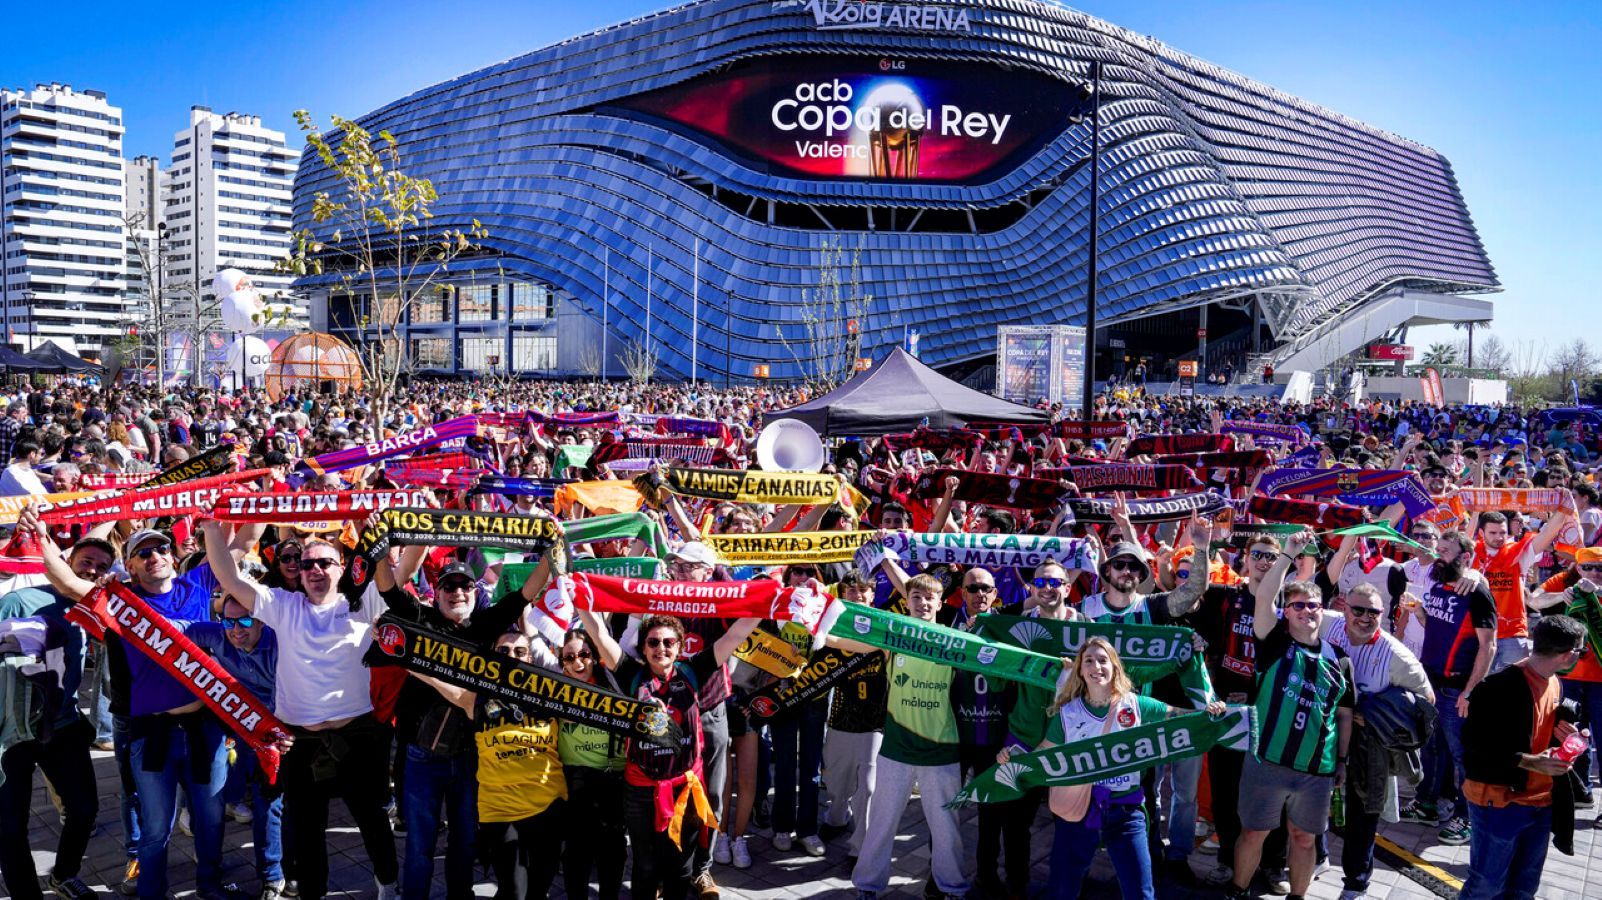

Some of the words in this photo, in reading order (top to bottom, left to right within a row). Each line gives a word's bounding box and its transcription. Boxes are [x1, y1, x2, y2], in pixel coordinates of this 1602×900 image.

[886, 6, 971, 32] ARENA
[892, 61, 906, 70] LG
[795, 79, 853, 102] acb
[771, 99, 881, 137] Copa
[889, 109, 932, 130] del
[941, 105, 1011, 145] Rey
[205, 432, 216, 445] 14
[366, 427, 437, 456] BARÇA
[82, 475, 106, 487] AM
[675, 470, 740, 494] VAMOS
[745, 477, 834, 498] CANARIAS
[1073, 466, 1156, 488] BASKONIA
[229, 494, 339, 514] MURCIA
[350, 491, 427, 511] UCAM
[1091, 500, 1137, 516] REL
[1138, 493, 1208, 515] MADRID
[909, 537, 918, 560] ACB
[922, 533, 1061, 553] UNICAJA
[926, 548, 961, 563] C.B.
[577, 563, 642, 578] nicaja
[623, 578, 748, 599] Casademont
[648, 599, 717, 614] ZARAGOZA
[1240, 614, 1254, 624] SP
[888, 618, 966, 649] Unicaja
[1062, 626, 1192, 663] Uicaja
[106, 593, 174, 656] UCAM
[173, 651, 262, 732] MURCIA
[750, 642, 798, 670] Aniversari
[413, 635, 501, 683] ¡VAMOS,
[508, 668, 638, 719] CANARIAS!
[911, 680, 948, 692] Unicaja
[974, 674, 988, 694] 0
[411, 656, 433, 669] 2017,
[434, 663, 454, 678] 2018,
[456, 672, 477, 686] 2019,
[478, 679, 500, 693] 2020,
[500, 686, 520, 699] 2021,
[522, 693, 543, 707] 2022,
[544, 700, 565, 714] 2023,
[566, 706, 588, 720] 2024,
[589, 712, 610, 726] 2025,
[611, 716, 631, 729] 2026
[858, 681, 867, 700] 9
[901, 697, 940, 710] málaga
[1294, 712, 1307, 731] 9
[484, 736, 500, 747] LA
[503, 735, 554, 745] LAGUNA
[1038, 727, 1192, 777] Unicaja
